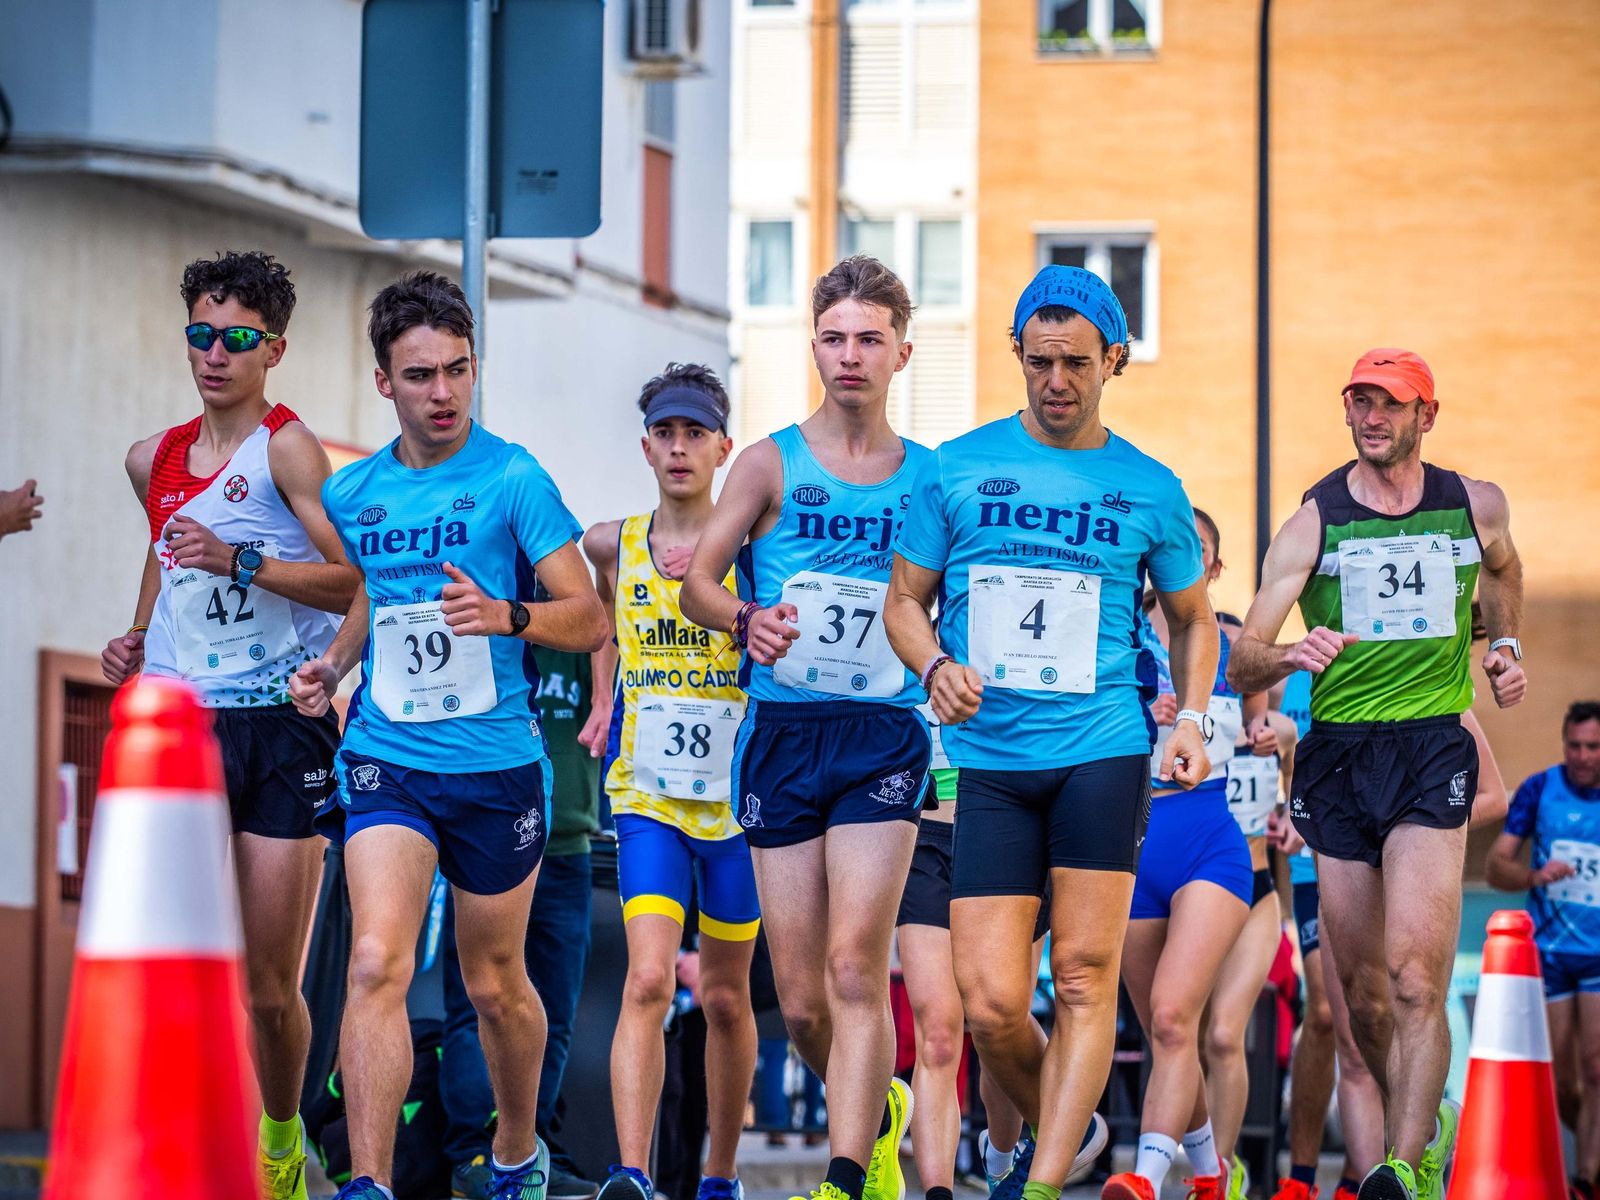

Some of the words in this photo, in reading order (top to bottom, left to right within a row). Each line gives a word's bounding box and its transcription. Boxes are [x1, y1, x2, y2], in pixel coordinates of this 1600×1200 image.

[794, 488, 829, 503] TROPS
[978, 479, 1018, 494] TROPS
[358, 509, 386, 524] TROPS
[976, 501, 1121, 547] nerja
[360, 515, 471, 559] nerja
[998, 541, 1100, 569] ATLETISMO
[376, 560, 455, 581] ATLETISM
[1378, 560, 1426, 599] 34
[206, 583, 254, 626] 42
[1020, 599, 1046, 640] 4
[818, 604, 877, 649] 37
[404, 631, 451, 675] 39
[626, 668, 683, 688] OLIMPO
[664, 722, 712, 758] 38
[1229, 776, 1257, 803] 21
